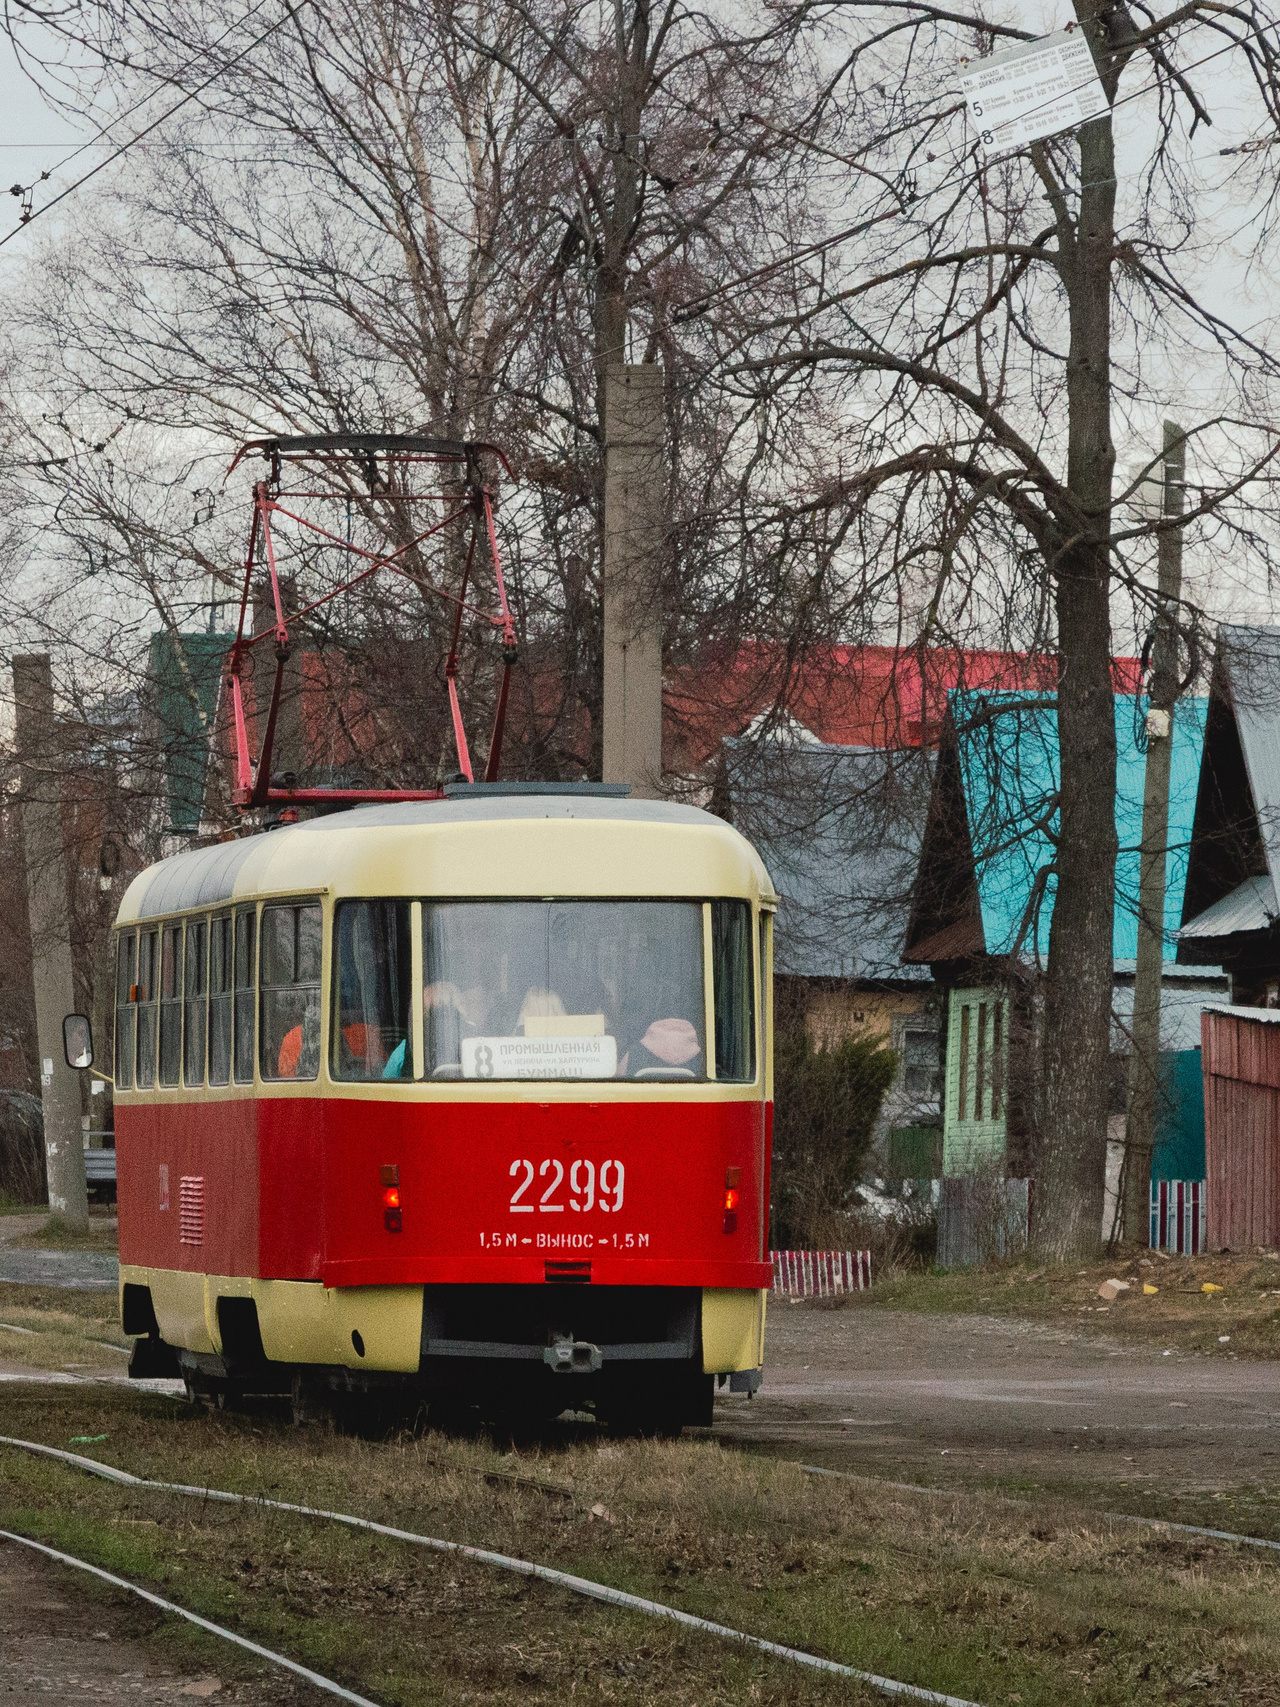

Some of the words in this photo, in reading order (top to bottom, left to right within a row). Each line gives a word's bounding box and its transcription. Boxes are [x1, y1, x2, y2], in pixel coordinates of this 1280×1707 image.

[973, 102, 983, 117] 5
[982, 130, 994, 144] 8
[474, 1045, 494, 1078] 8
[500, 1042, 601, 1056] ПРОМЫШЛЕННАЯ
[509, 1159, 625, 1212] 2299
[479, 1232, 502, 1248] 1,5
[536, 1233, 594, 1248] ВЫНОС
[612, 1233, 635, 1249] 1,5
